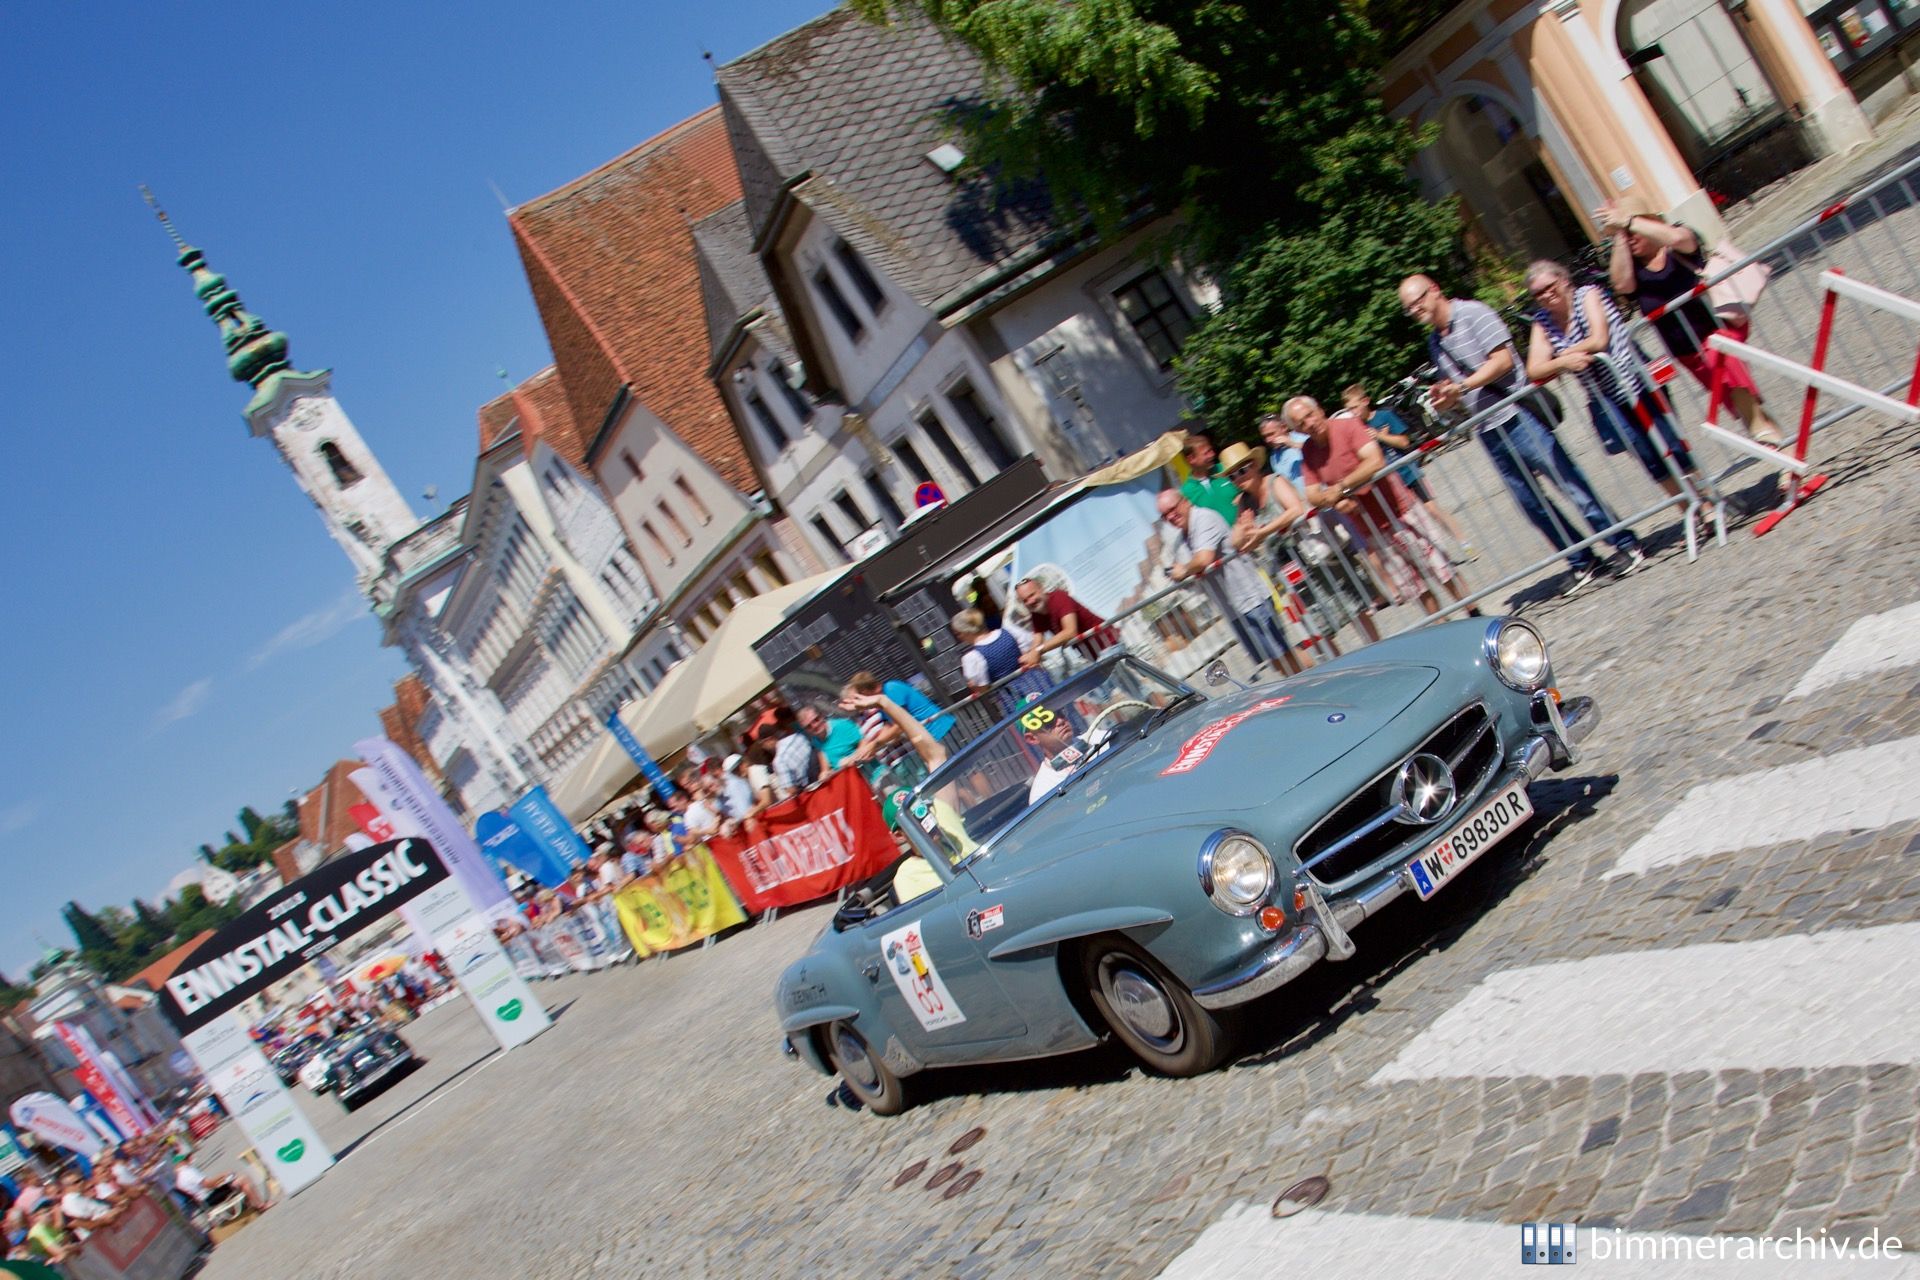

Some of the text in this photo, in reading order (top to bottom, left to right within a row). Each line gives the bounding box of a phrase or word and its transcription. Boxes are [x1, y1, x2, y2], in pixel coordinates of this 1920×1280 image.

[1021, 705, 1055, 730] 65
[1424, 791, 1525, 881] W 69830 R
[164, 838, 429, 1017] ENNSTAL-CLASSIC
